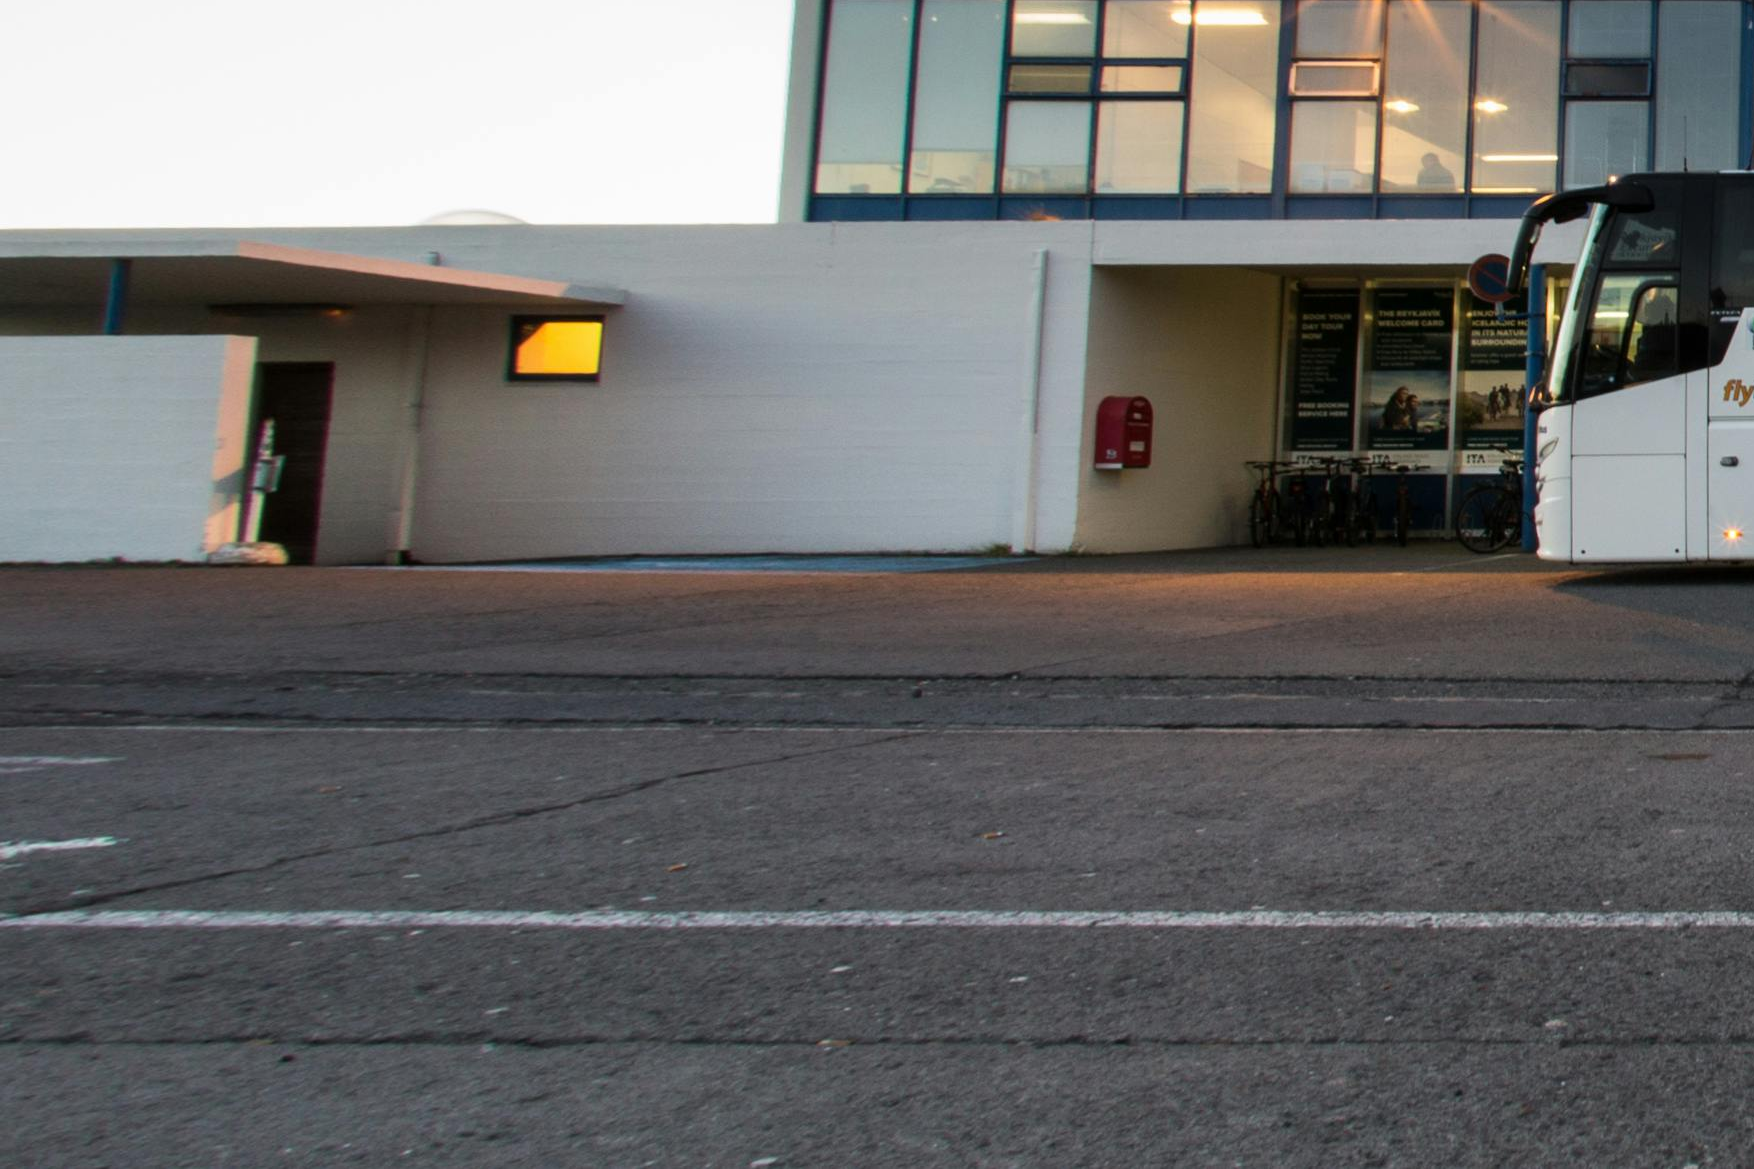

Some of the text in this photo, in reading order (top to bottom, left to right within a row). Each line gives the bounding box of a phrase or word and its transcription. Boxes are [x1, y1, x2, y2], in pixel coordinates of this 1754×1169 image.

[1379, 310, 1395, 318] THE
[1378, 319, 1445, 327] WELCOME CARD
[1317, 402, 1350, 410] BOOKING
[1298, 411, 1328, 419] SERVICE
[1466, 454, 1486, 464] ITA
